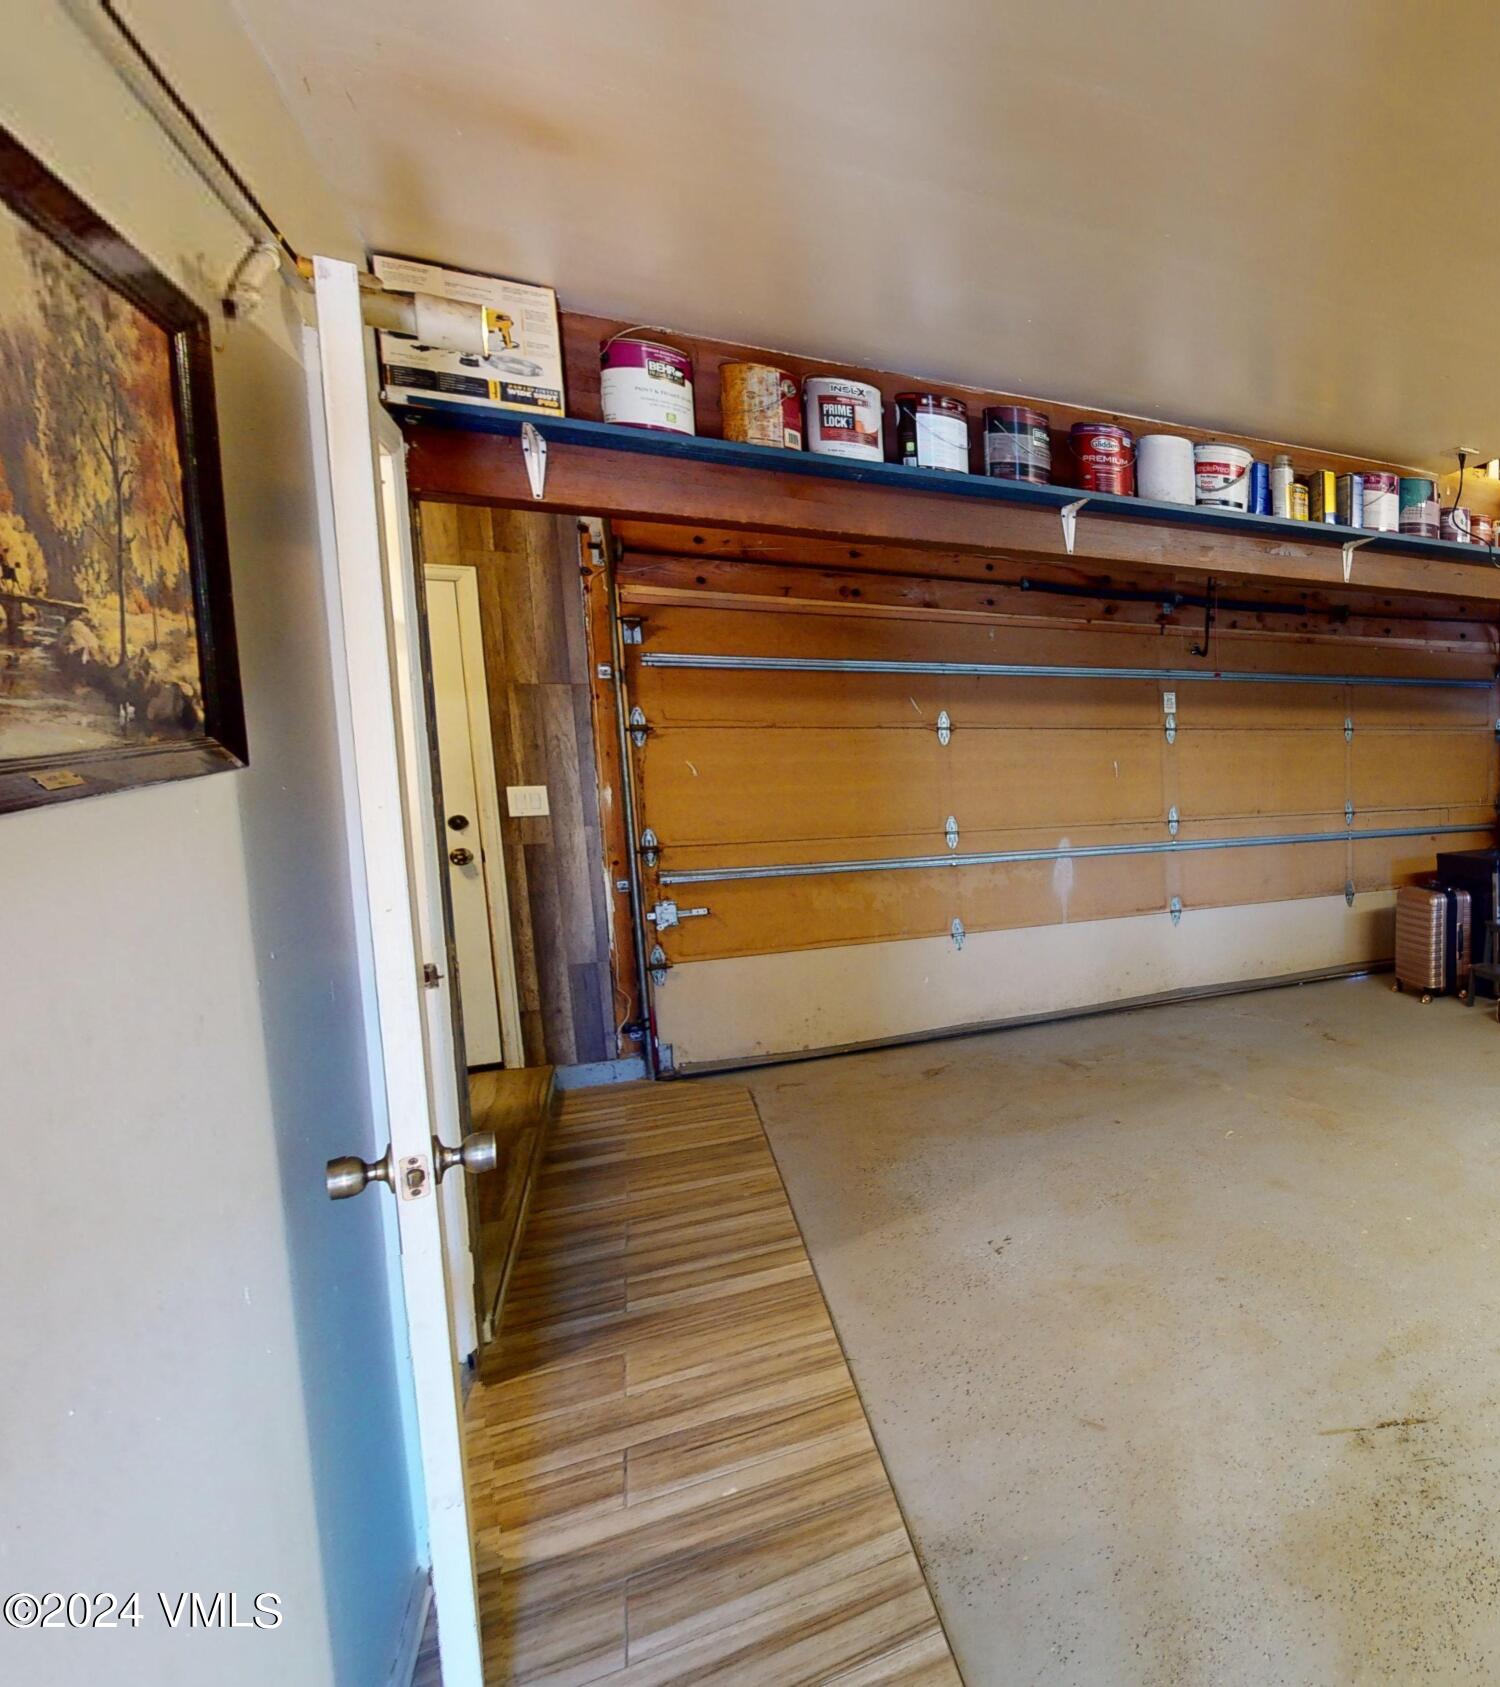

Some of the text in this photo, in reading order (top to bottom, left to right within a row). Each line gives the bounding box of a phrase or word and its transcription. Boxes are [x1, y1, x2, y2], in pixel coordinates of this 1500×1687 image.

[648, 360, 676, 376] BEHR
[822, 403, 853, 417] PRIME
[824, 414, 849, 429] LOCK
[1081, 454, 1129, 466] PREMIUM
